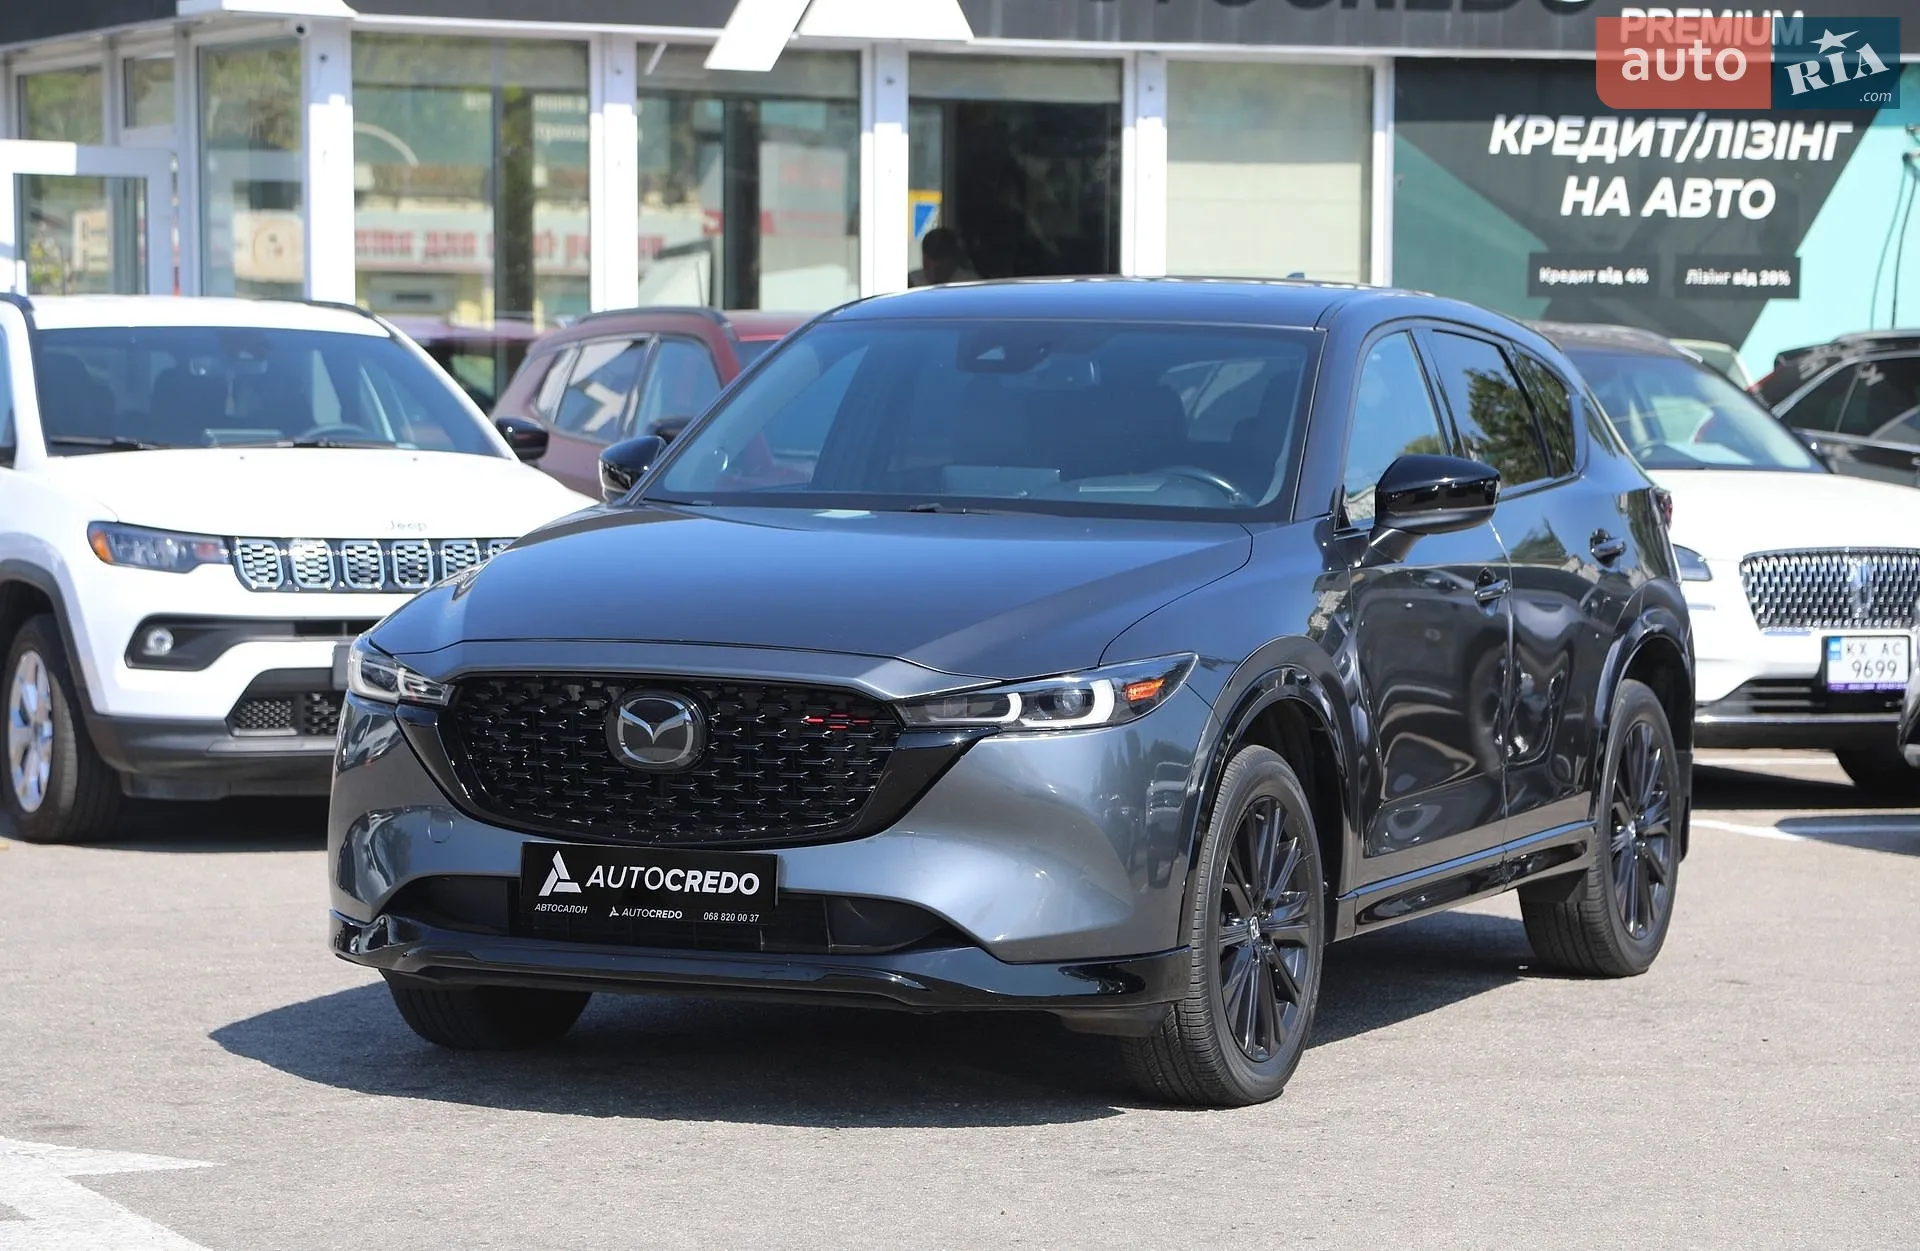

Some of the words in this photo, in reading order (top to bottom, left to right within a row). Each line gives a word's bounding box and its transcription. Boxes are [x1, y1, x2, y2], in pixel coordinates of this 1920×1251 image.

[1620, 8, 1804, 45] PREMIUM
[1488, 112, 1853, 164] КРЕДИТ/ЛІЗІНГ
[1560, 175, 1631, 217] НА
[1641, 177, 1777, 220] АВТО
[1539, 267, 1595, 285] Кредит
[1597, 266, 1623, 285] від
[1625, 268, 1649, 284] 4%
[1685, 268, 1731, 285] Лізінг
[1732, 268, 1758, 287] від
[386, 520, 428, 532] Jeep
[1851, 660, 1897, 678] 9699
[585, 865, 760, 896] AUTOCREDO
[534, 903, 588, 914] АВТОСАЛОН
[621, 908, 683, 920] AUTOCREDO
[703, 911, 719, 921] 068
[720, 912, 736, 922] 820
[737, 913, 748, 922] 00
[749, 913, 760, 922] 37
